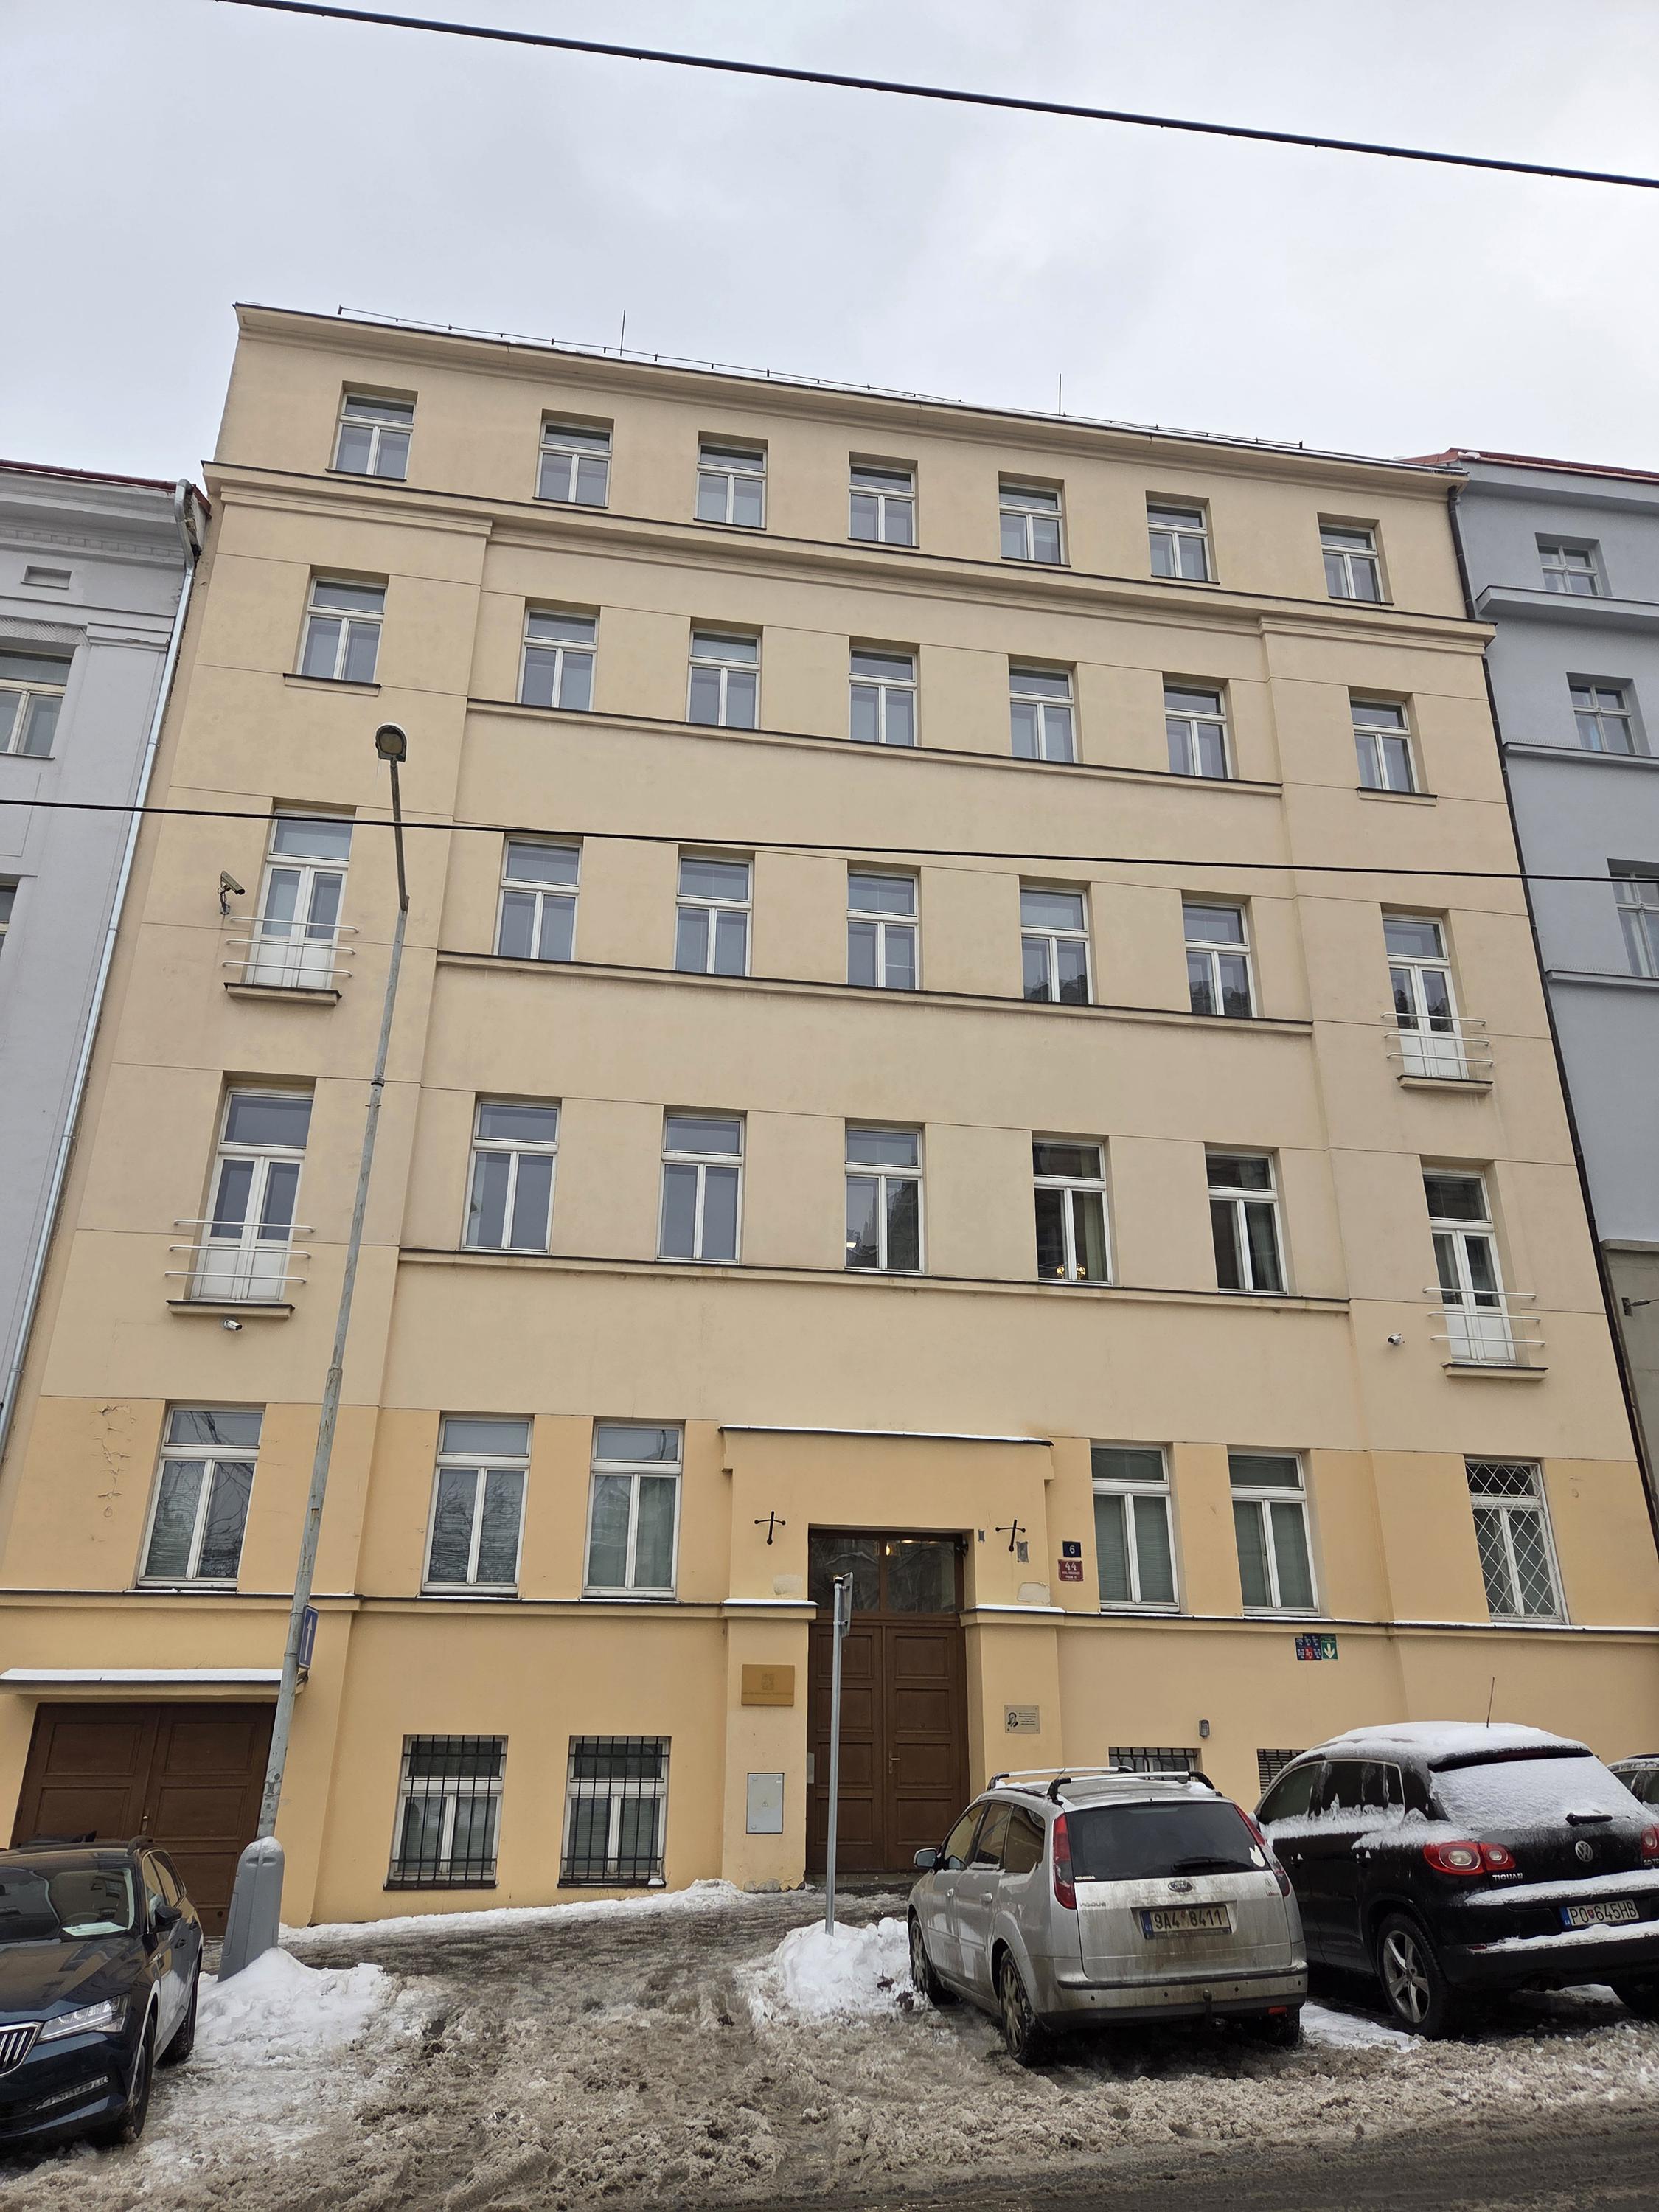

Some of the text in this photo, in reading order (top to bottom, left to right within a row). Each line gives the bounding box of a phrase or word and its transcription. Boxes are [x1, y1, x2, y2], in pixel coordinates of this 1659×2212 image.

[1069, 1545, 1075, 1554] 6
[1065, 1562, 1077, 1571] 44
[1492, 1873, 1523, 1881] TIGUAN
[1569, 1902, 1637, 1924] PO 645HB
[1154, 1909, 1222, 1930] 9A4 8411
